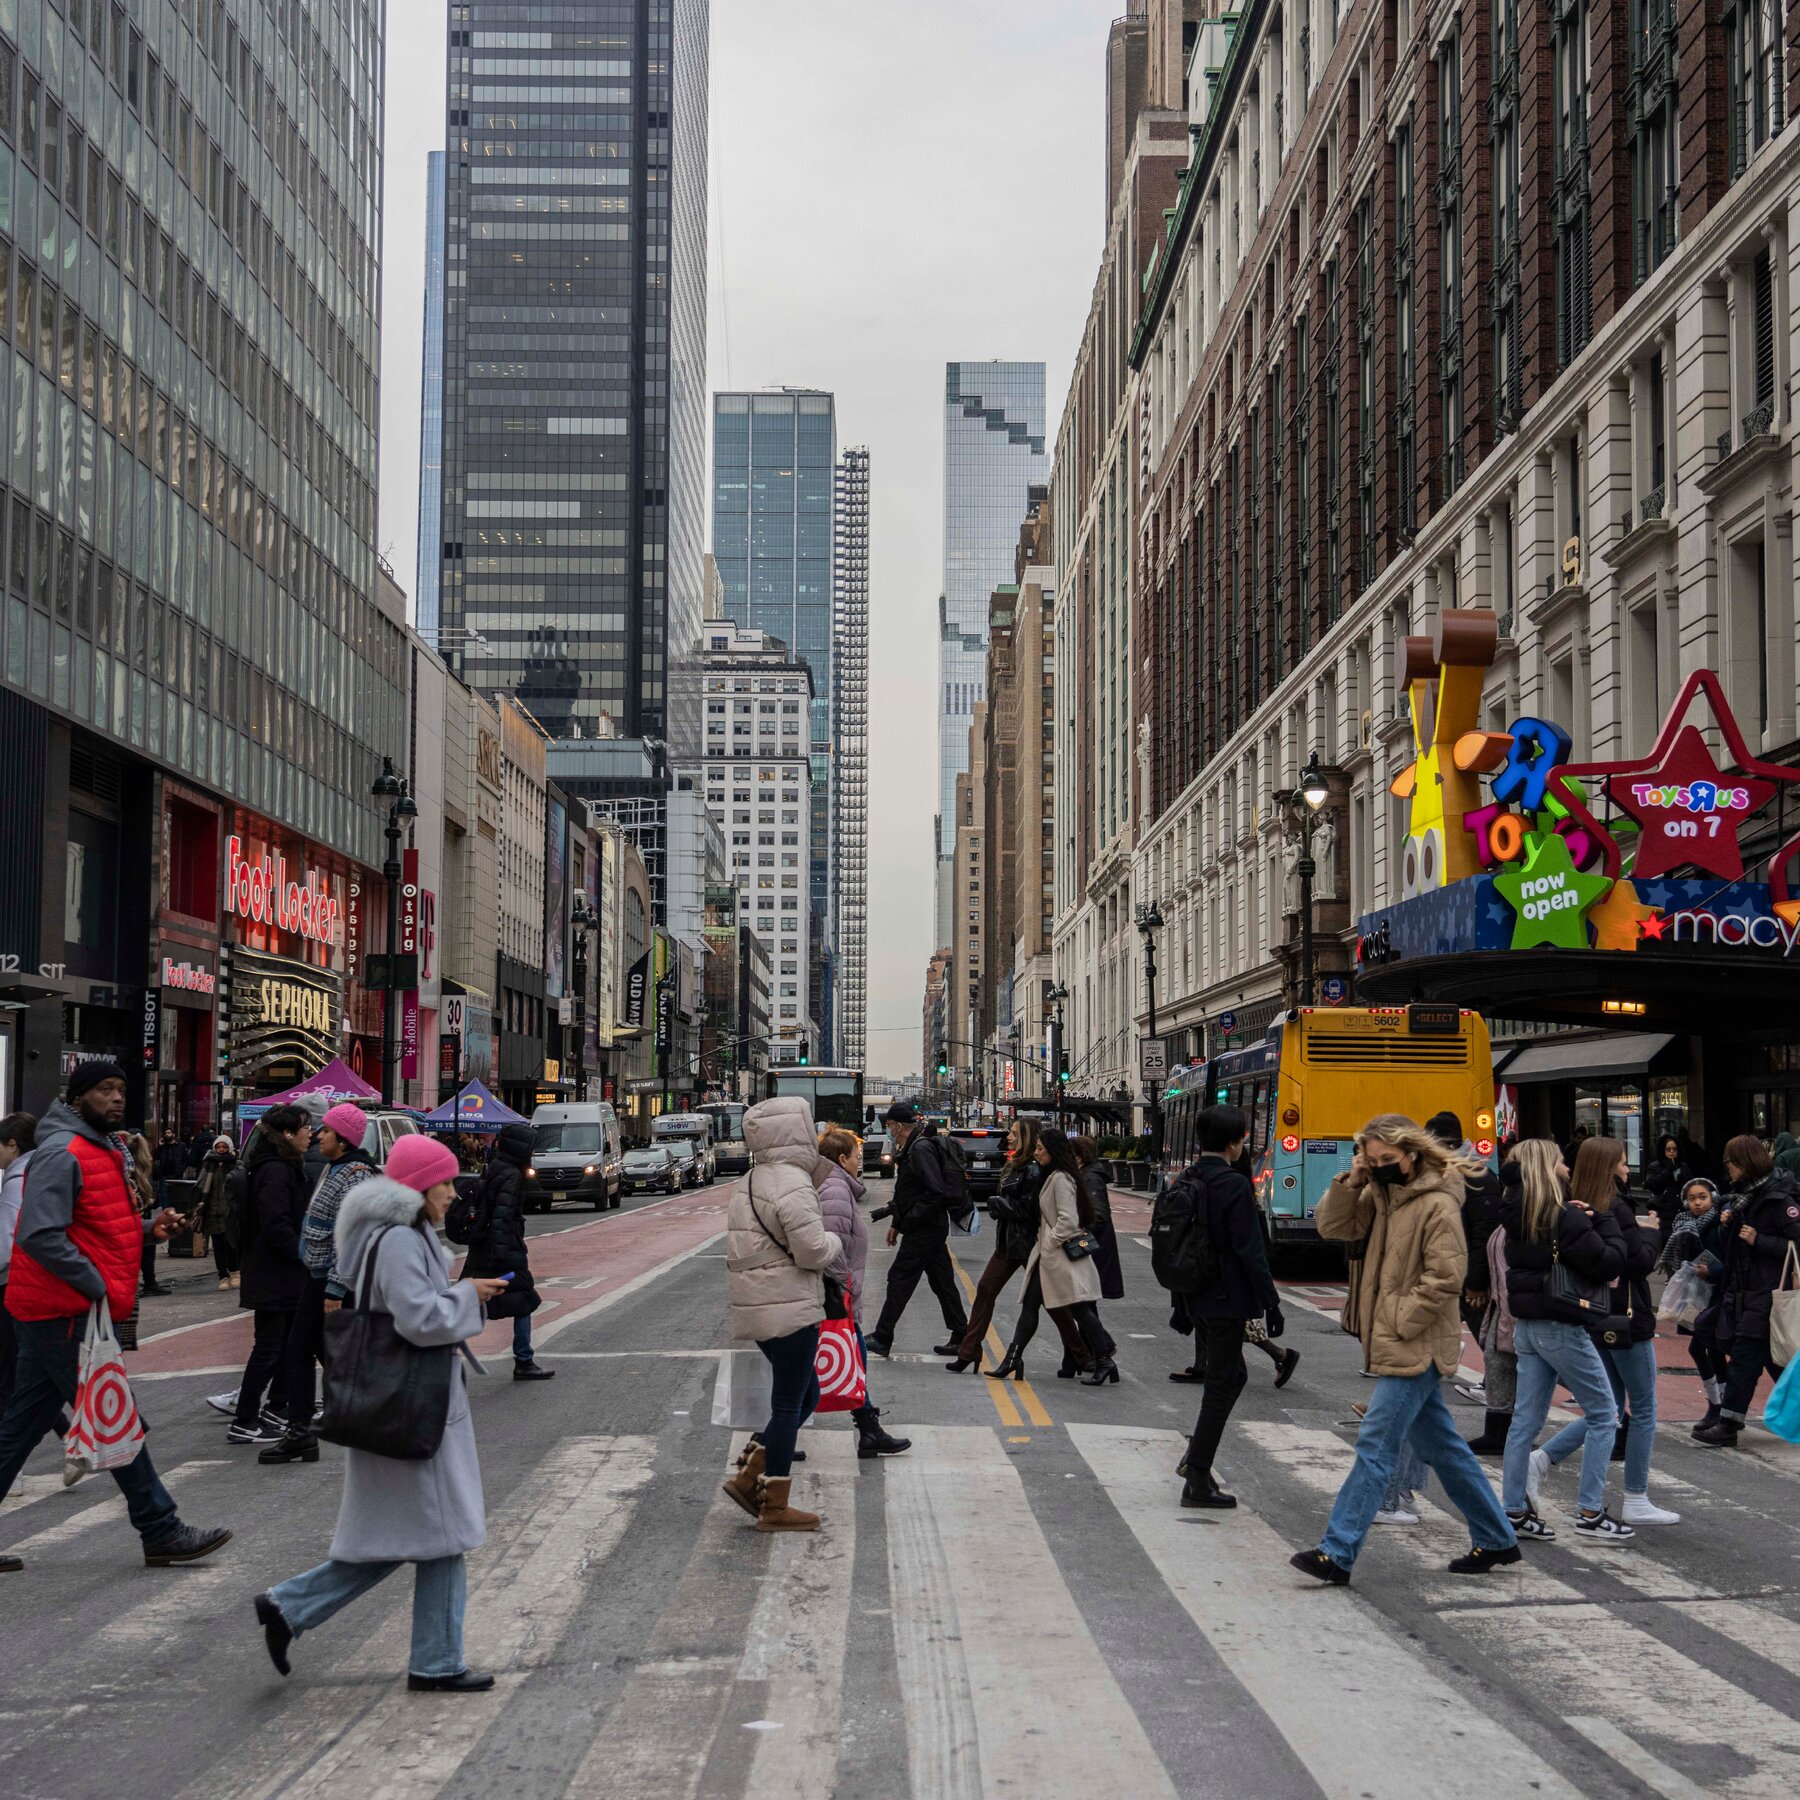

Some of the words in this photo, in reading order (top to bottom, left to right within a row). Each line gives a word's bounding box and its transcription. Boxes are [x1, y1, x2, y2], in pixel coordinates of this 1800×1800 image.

[1663, 819, 1697, 837] on
[1703, 815, 1721, 837] 7
[225, 835, 273, 925] Foot
[276, 857, 336, 945] Locker
[1521, 872, 1565, 899] now
[1522, 889, 1579, 920] open
[403, 900, 414, 952] targ
[162, 957, 186, 989] Foot
[631, 974, 643, 998] OLD
[261, 979, 330, 1031] SEPHORA
[447, 999, 462, 1025] 30
[144, 991, 156, 1047] TISSOT
[1374, 1016, 1400, 1026] 5602
[1145, 1056, 1164, 1067] 25
[1661, 1092, 1682, 1104] GUCCI
